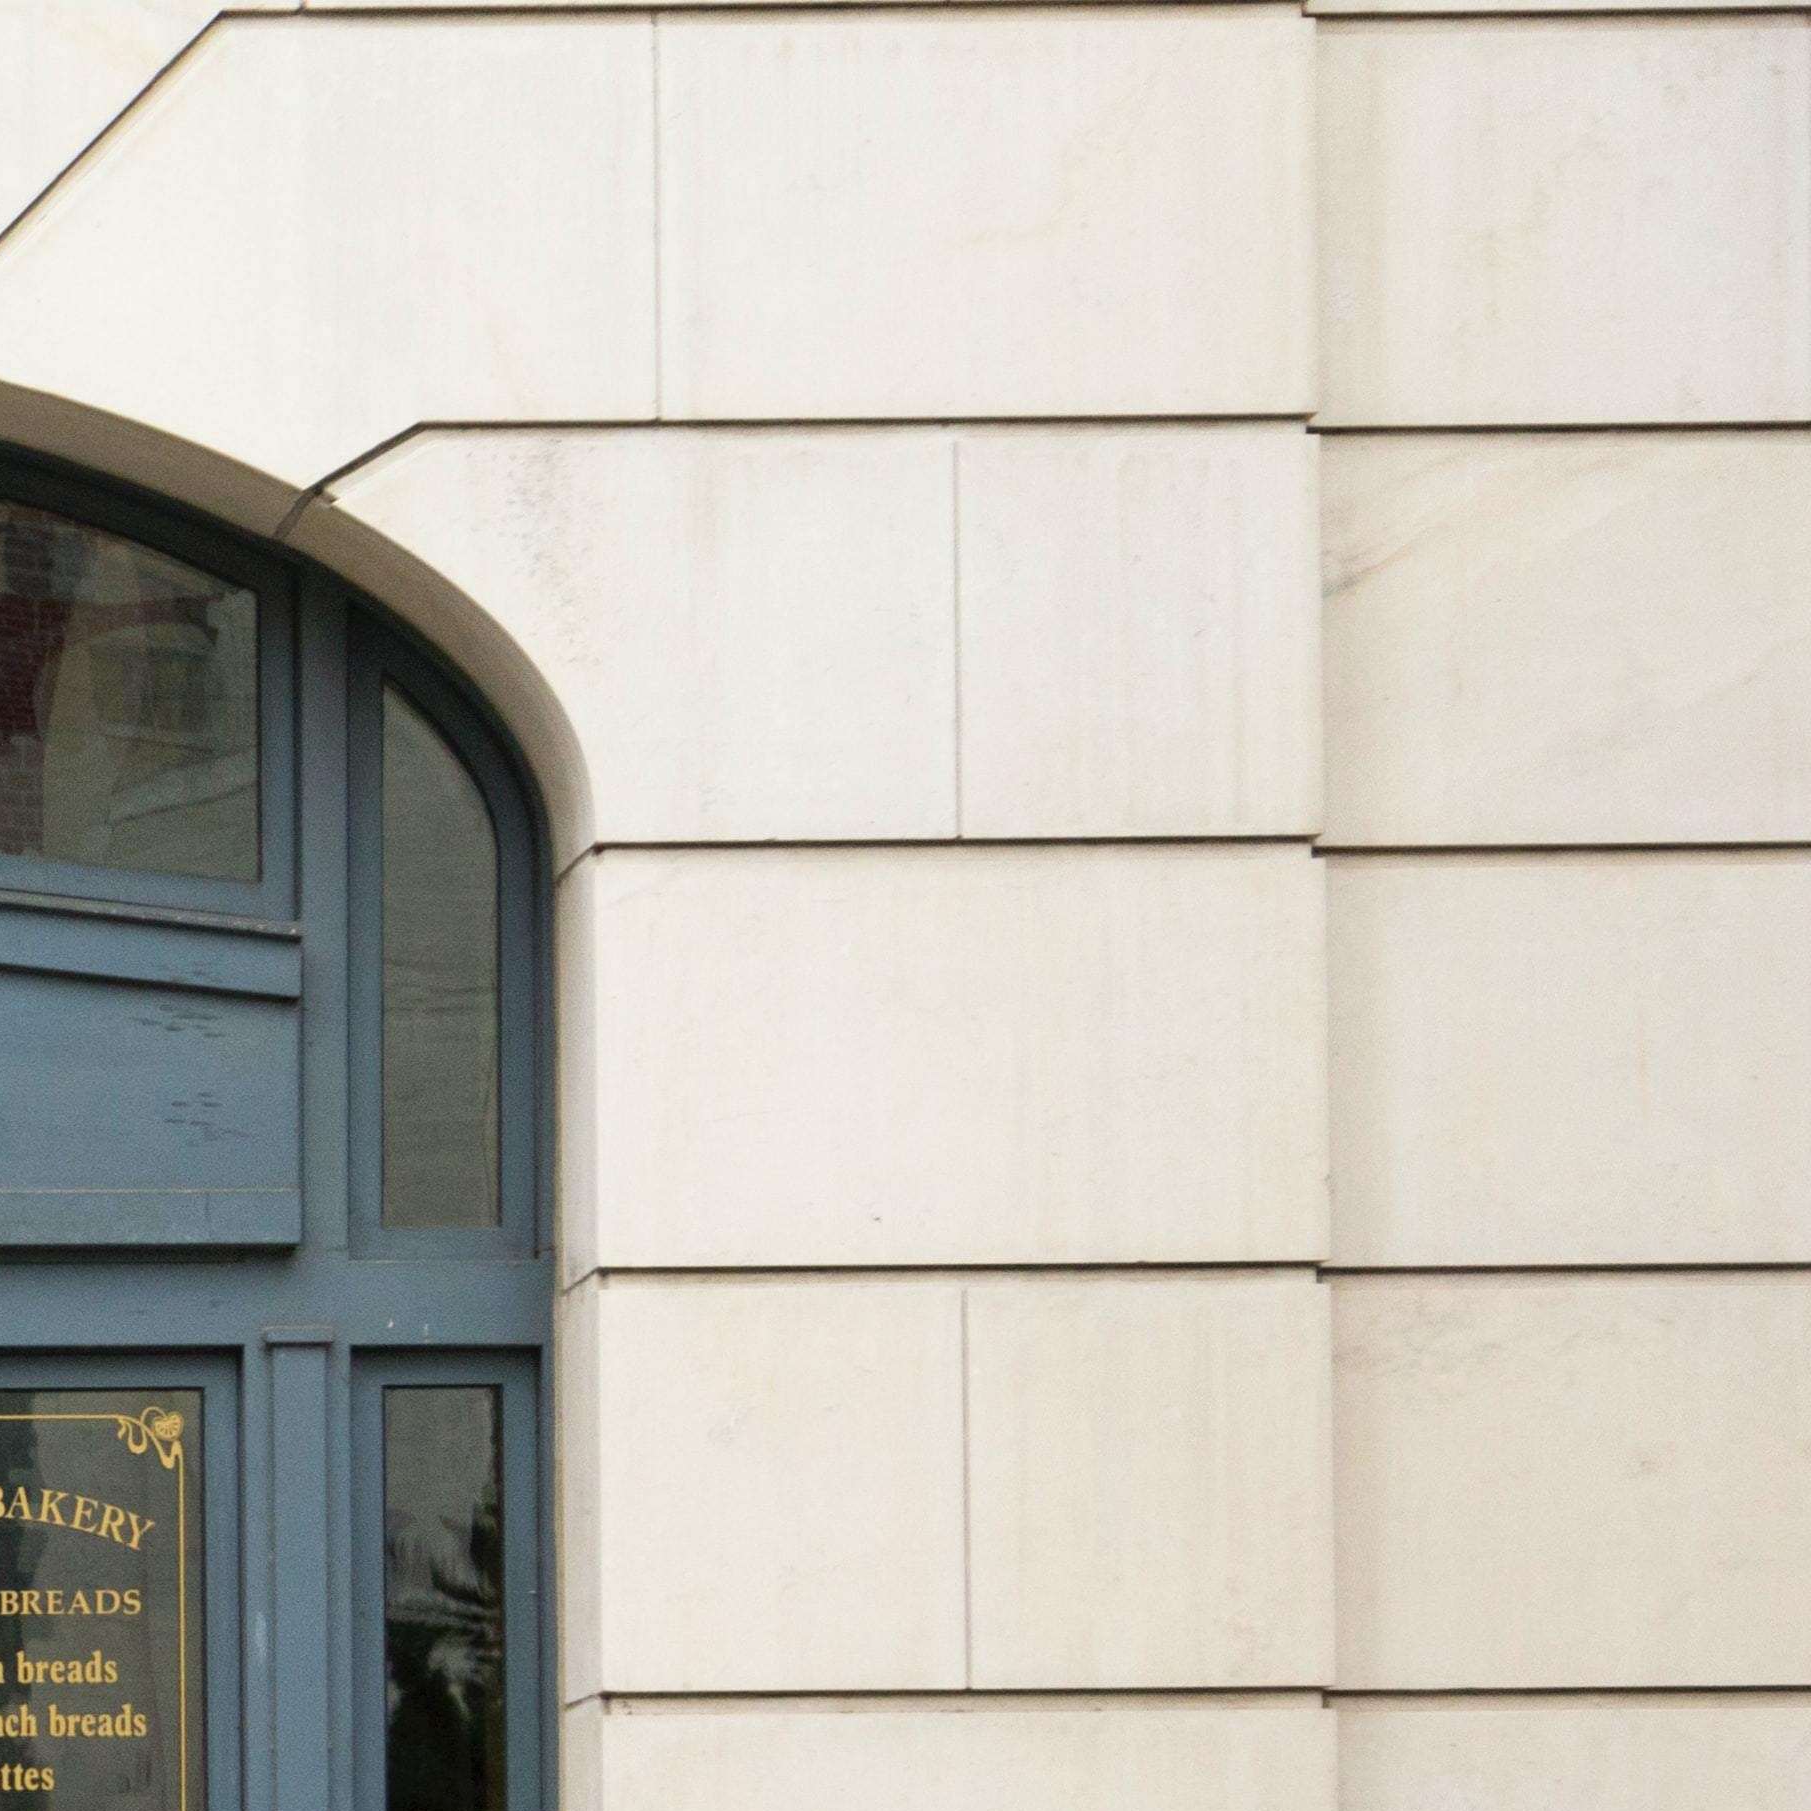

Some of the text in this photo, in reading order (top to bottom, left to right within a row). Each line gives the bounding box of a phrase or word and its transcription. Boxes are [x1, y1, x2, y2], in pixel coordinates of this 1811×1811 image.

[0, 1589, 142, 1616] BREADS
[16, 1649, 118, 1685] breads
[48, 1703, 147, 1738] breads
